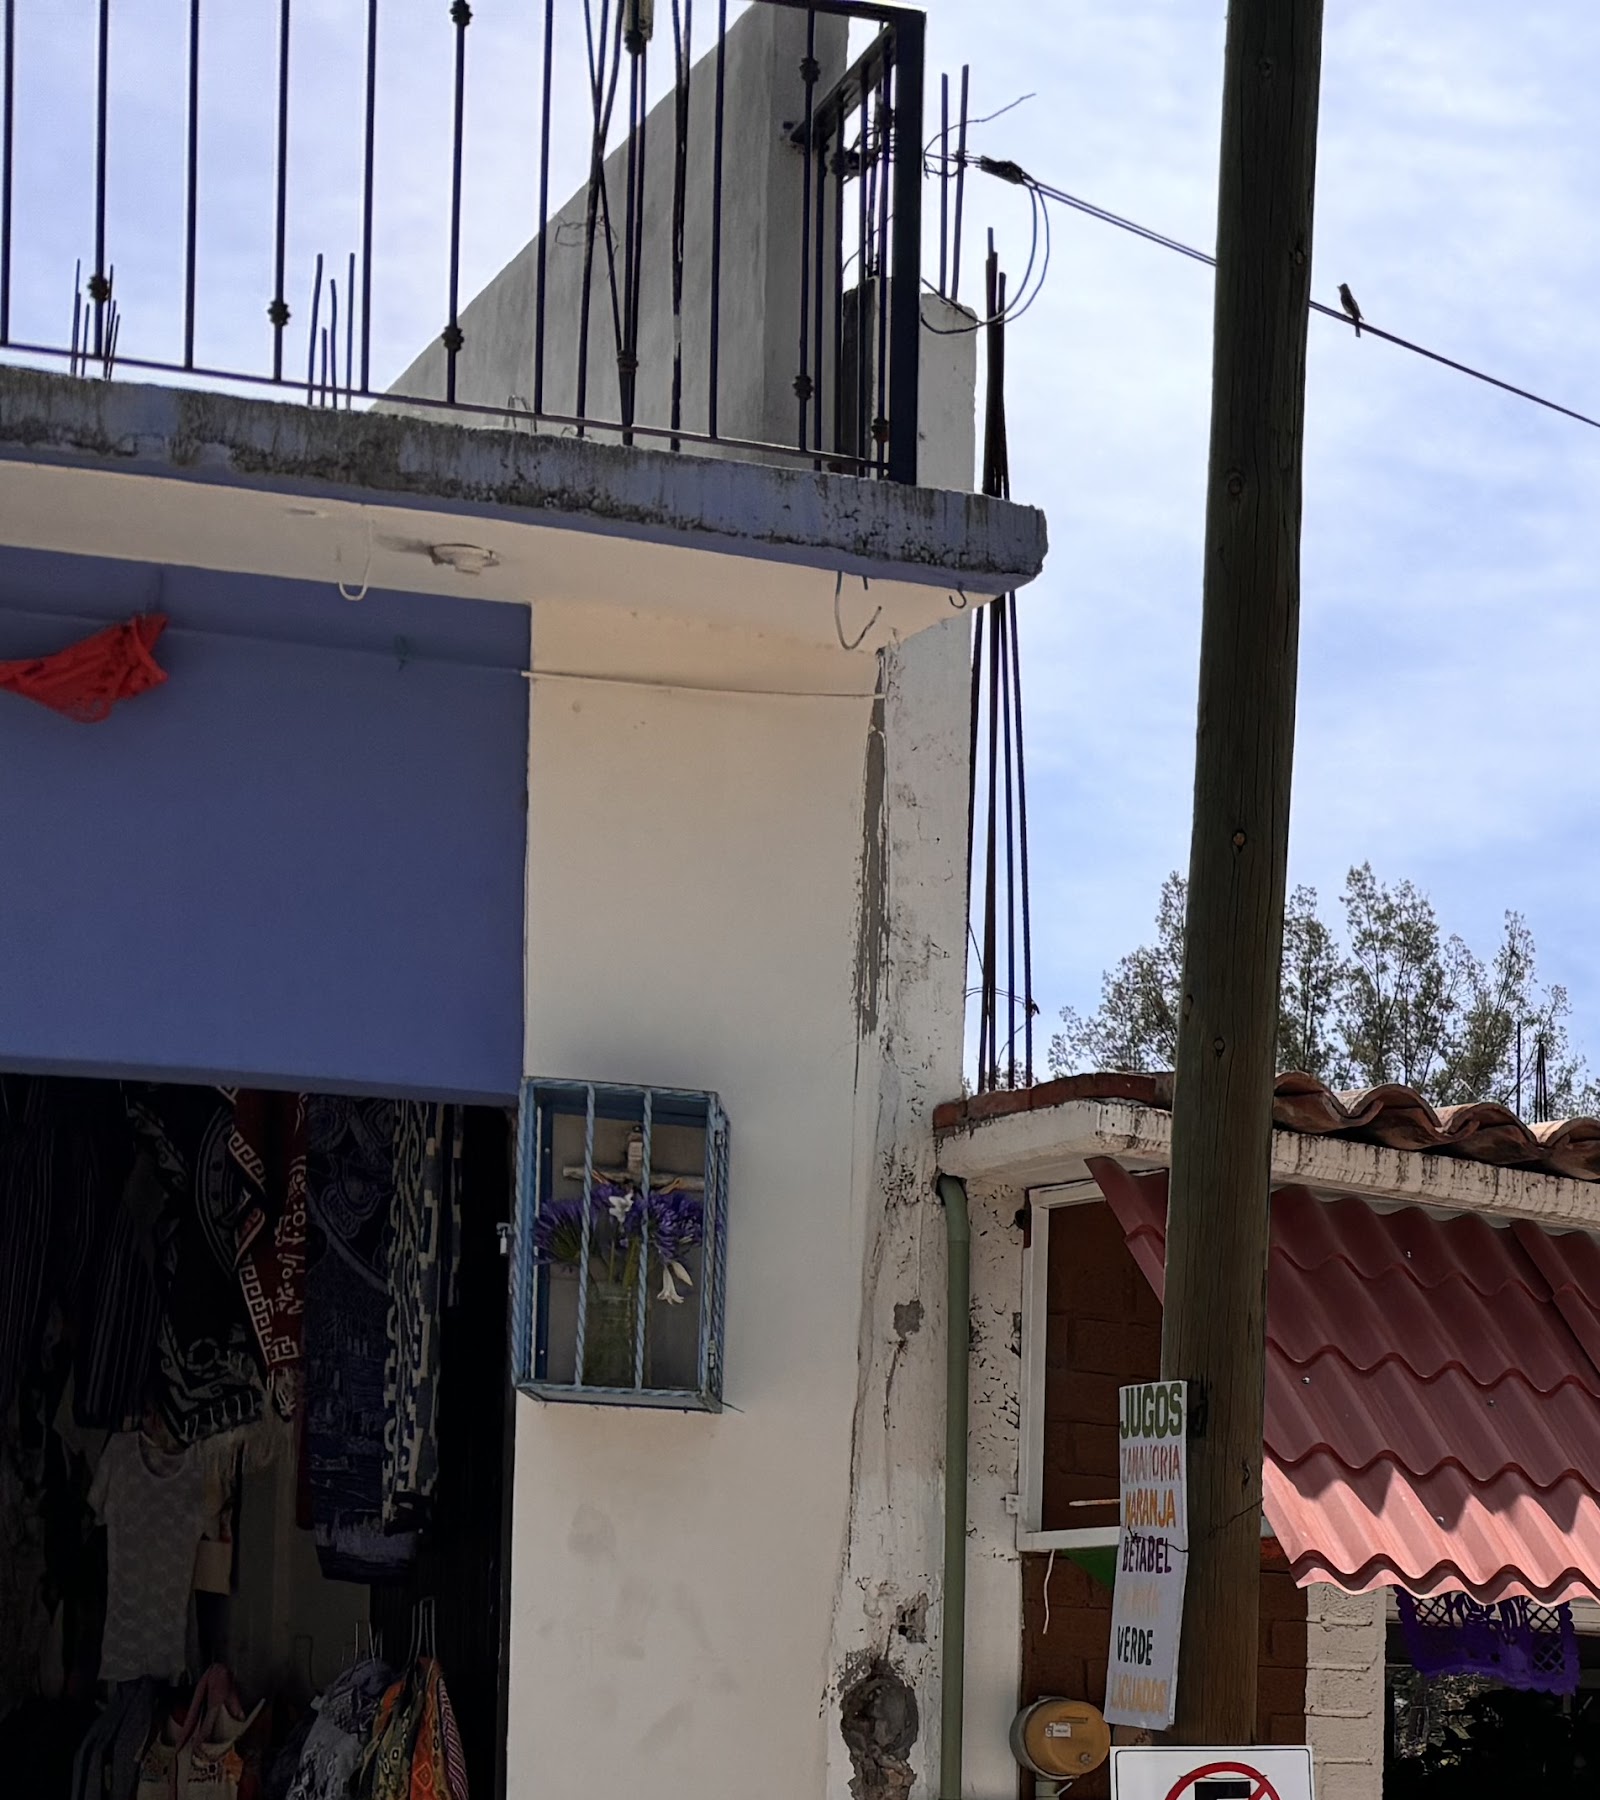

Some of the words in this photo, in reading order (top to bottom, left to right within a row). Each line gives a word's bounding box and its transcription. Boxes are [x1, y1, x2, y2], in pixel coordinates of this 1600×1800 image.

[1120, 1383, 1183, 1440] JUGOS
[1125, 1488, 1177, 1528] NARANJA
[1122, 1535, 1172, 1574] BETABEL
[1117, 1625, 1154, 1666] VERDE
